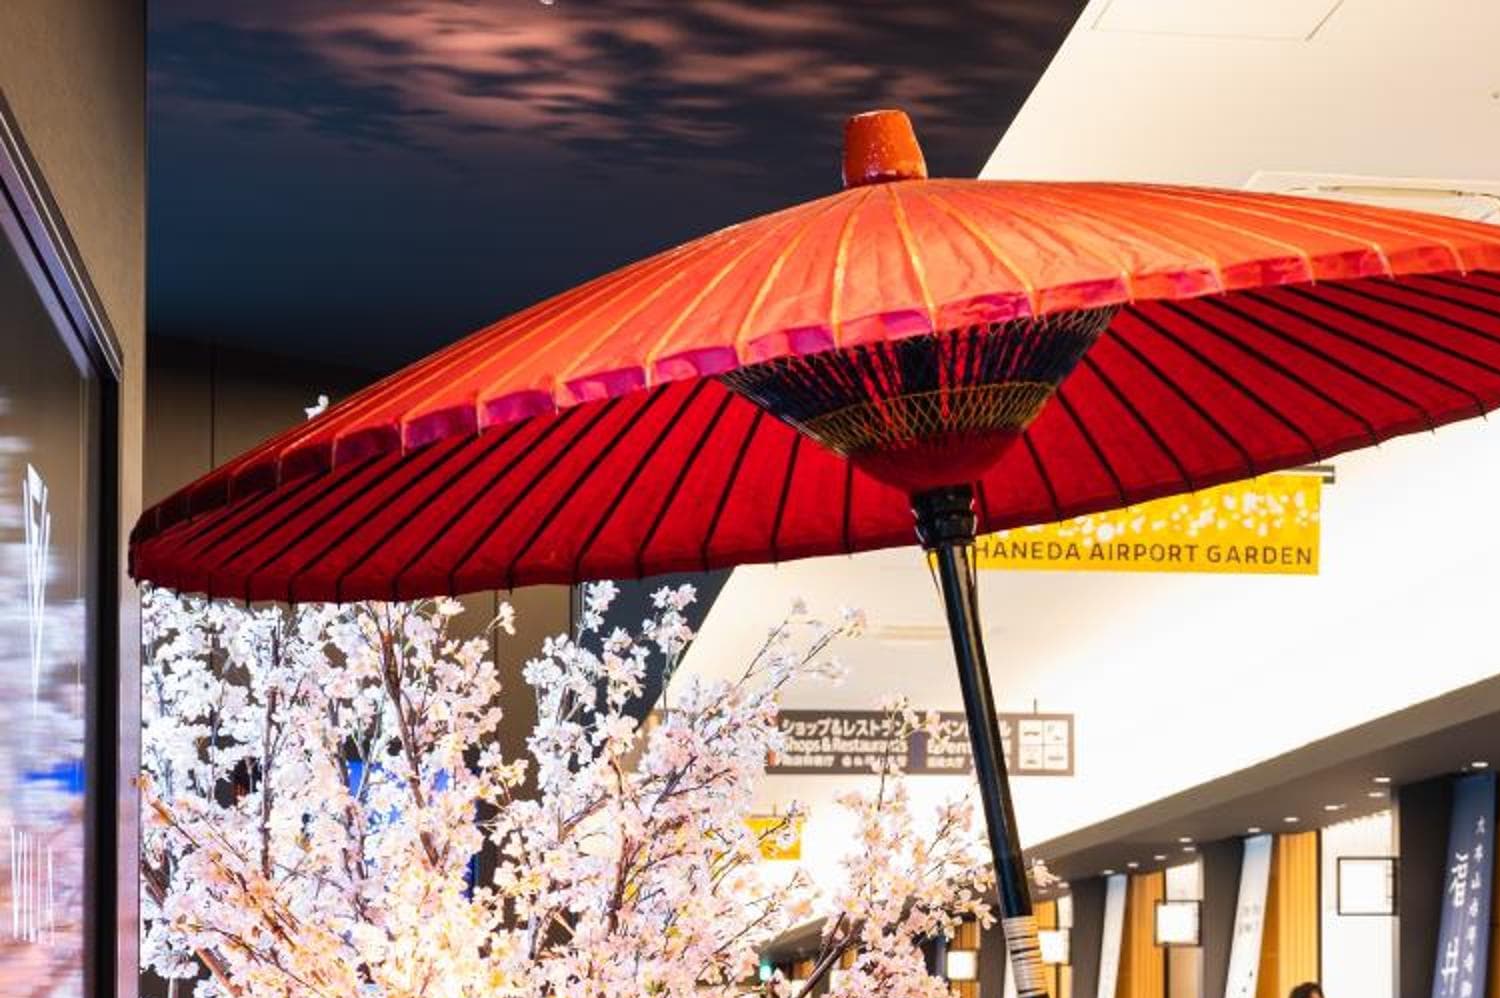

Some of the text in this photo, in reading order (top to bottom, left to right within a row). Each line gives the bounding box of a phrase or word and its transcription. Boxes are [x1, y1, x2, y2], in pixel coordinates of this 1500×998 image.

[975, 541, 1311, 565] HANEDA AIRPORT GARDEN
[784, 737, 820, 754] hops
